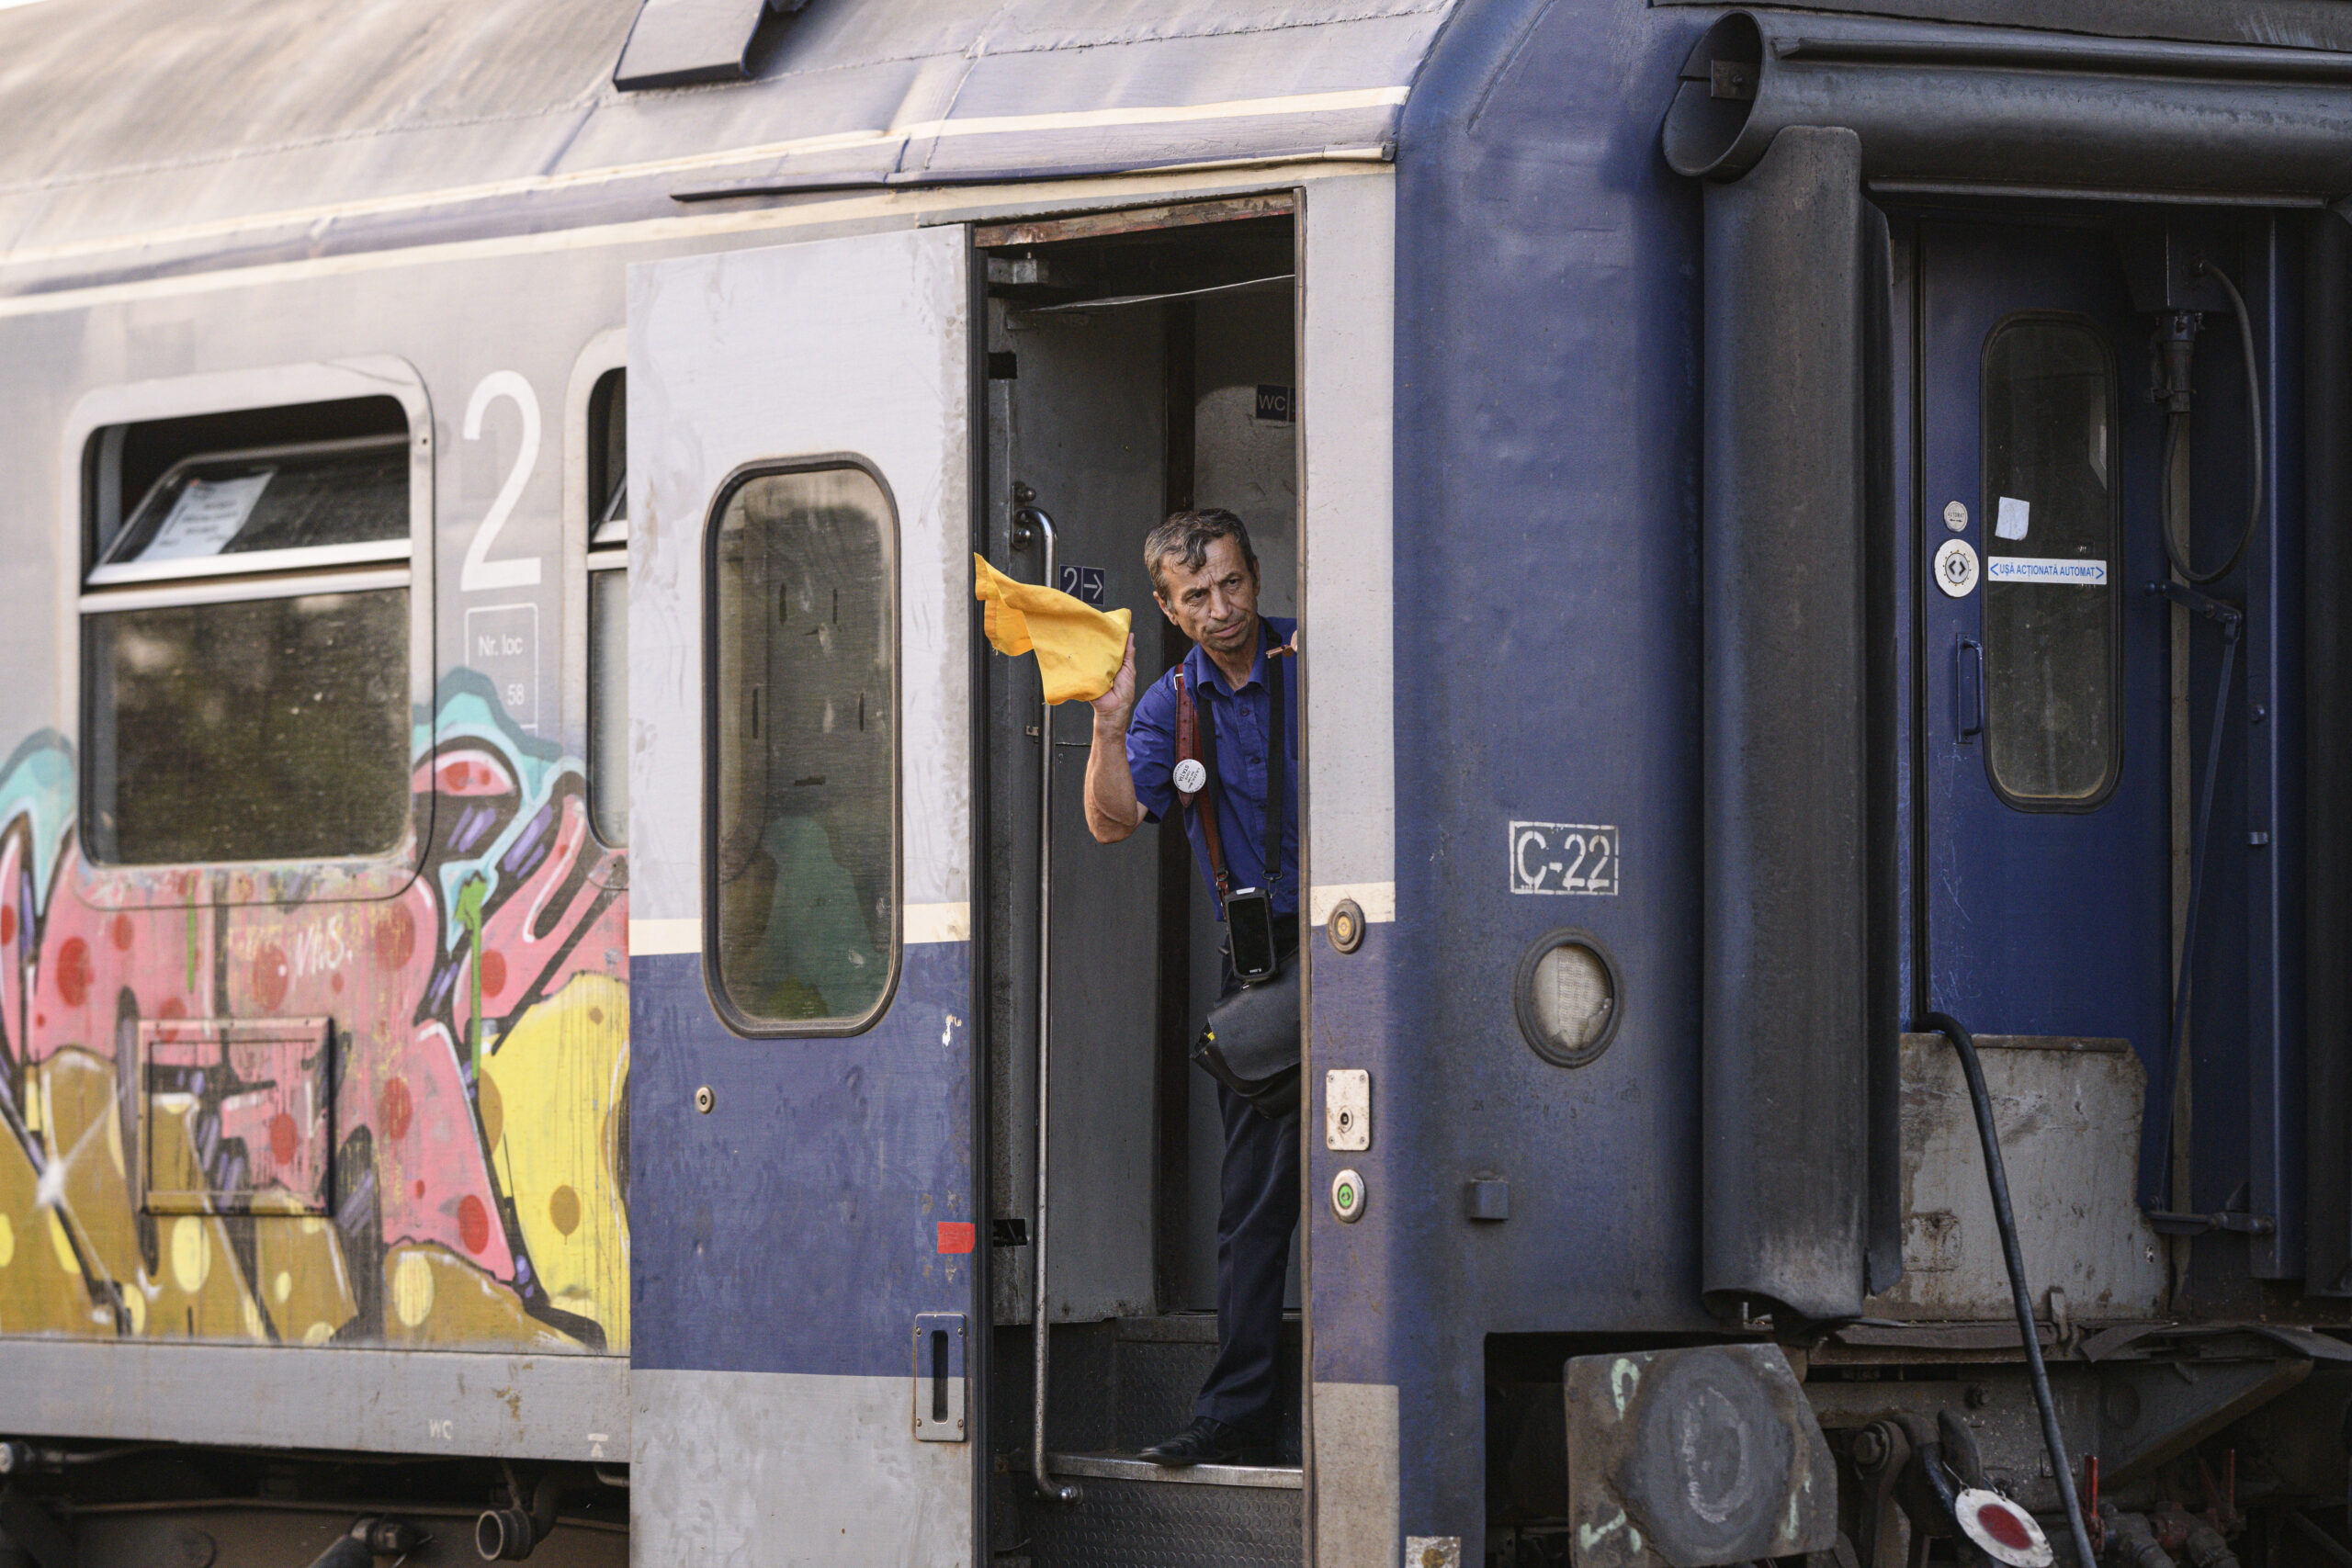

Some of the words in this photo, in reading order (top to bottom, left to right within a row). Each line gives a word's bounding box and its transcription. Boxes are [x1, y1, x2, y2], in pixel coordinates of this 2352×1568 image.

[1259, 394, 1286, 411] WC
[461, 370, 542, 591] 2
[1064, 567, 1078, 593] 2
[2060, 567, 2096, 577] AUTOMAT
[478, 635, 499, 657] Nr.
[502, 634, 524, 655] loc
[506, 682, 525, 705] 58
[1517, 830, 1611, 889] C-22
[429, 1418, 454, 1440] WC
